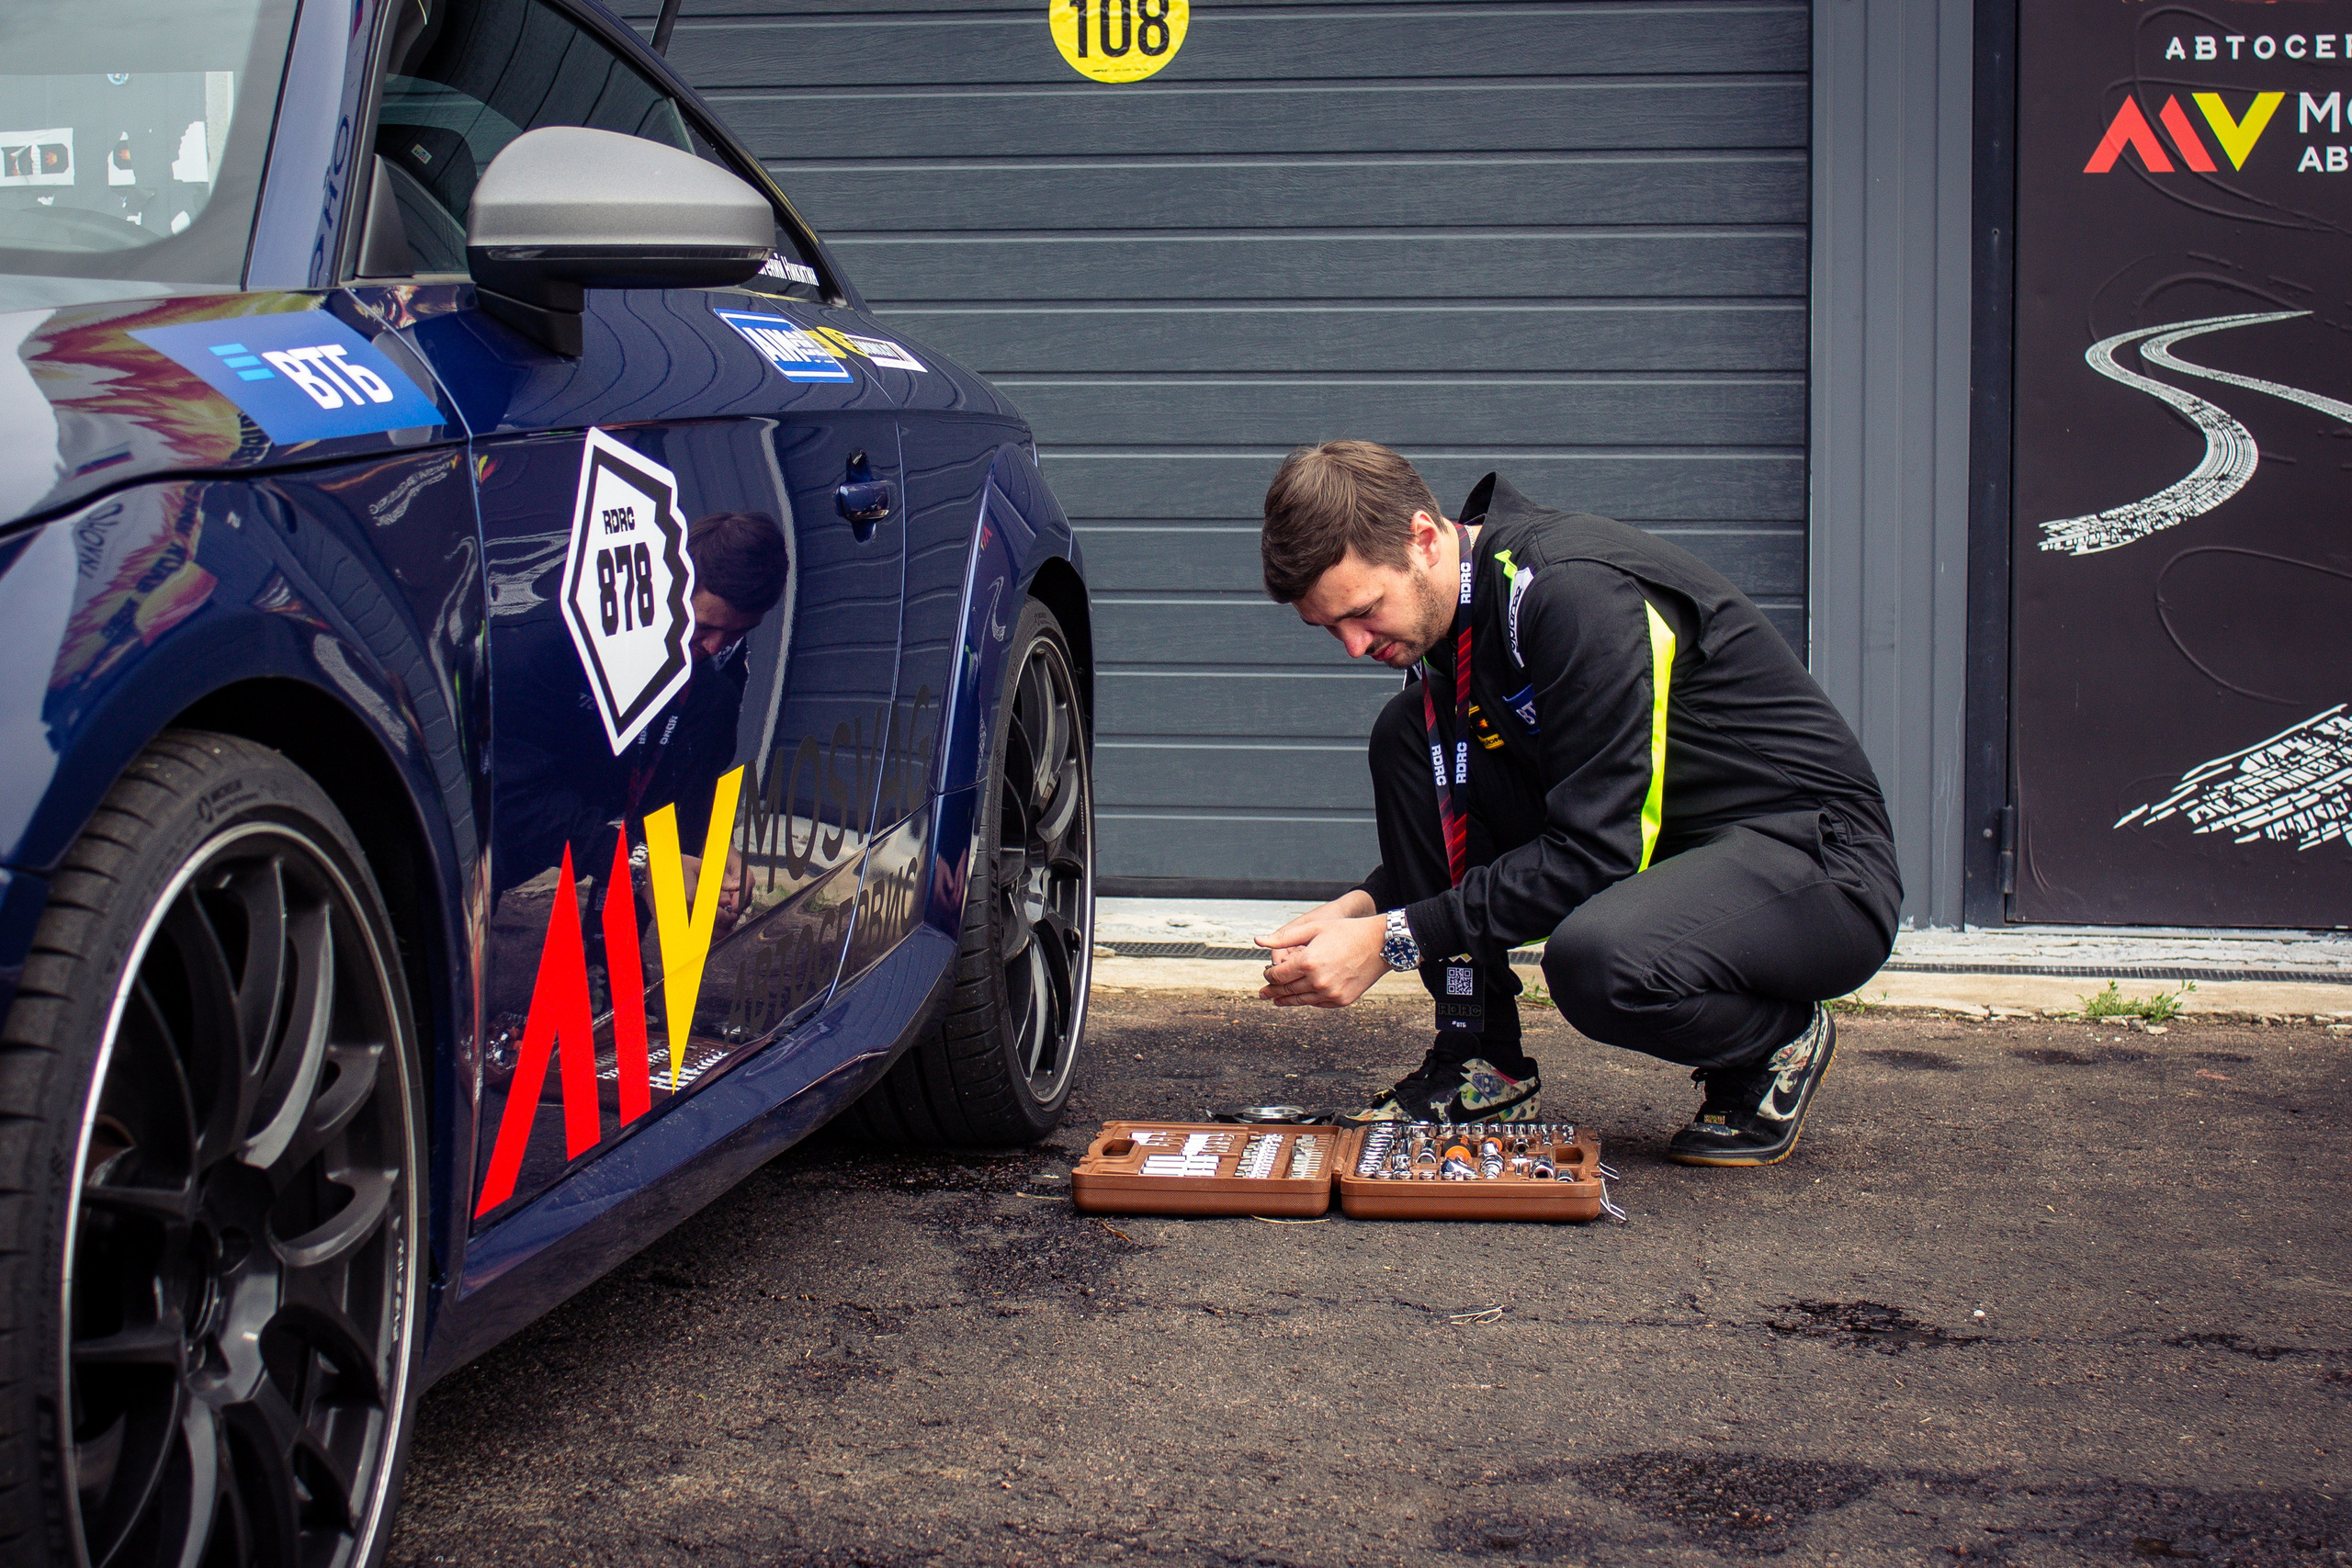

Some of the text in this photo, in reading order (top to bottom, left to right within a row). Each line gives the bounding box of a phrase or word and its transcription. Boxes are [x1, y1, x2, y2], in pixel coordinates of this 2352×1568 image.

[1069, 0, 1170, 58] 108
[2299, 92, 2352, 133] M
[2297, 145, 2352, 173] АВ
[262, 344, 394, 410] ВТБ
[602, 506, 636, 535] RDRC
[596, 542, 655, 637] 878
[1460, 561, 1473, 604] RDRC
[1516, 700, 1537, 726] ВТ
[1430, 744, 1447, 787] RDRC
[1455, 741, 1468, 784] RDRC
[739, 685, 932, 909] MOSVAG
[722, 856, 919, 1052] АВТОСЕРВИС
[1437, 1003, 1481, 1016] RDRC
